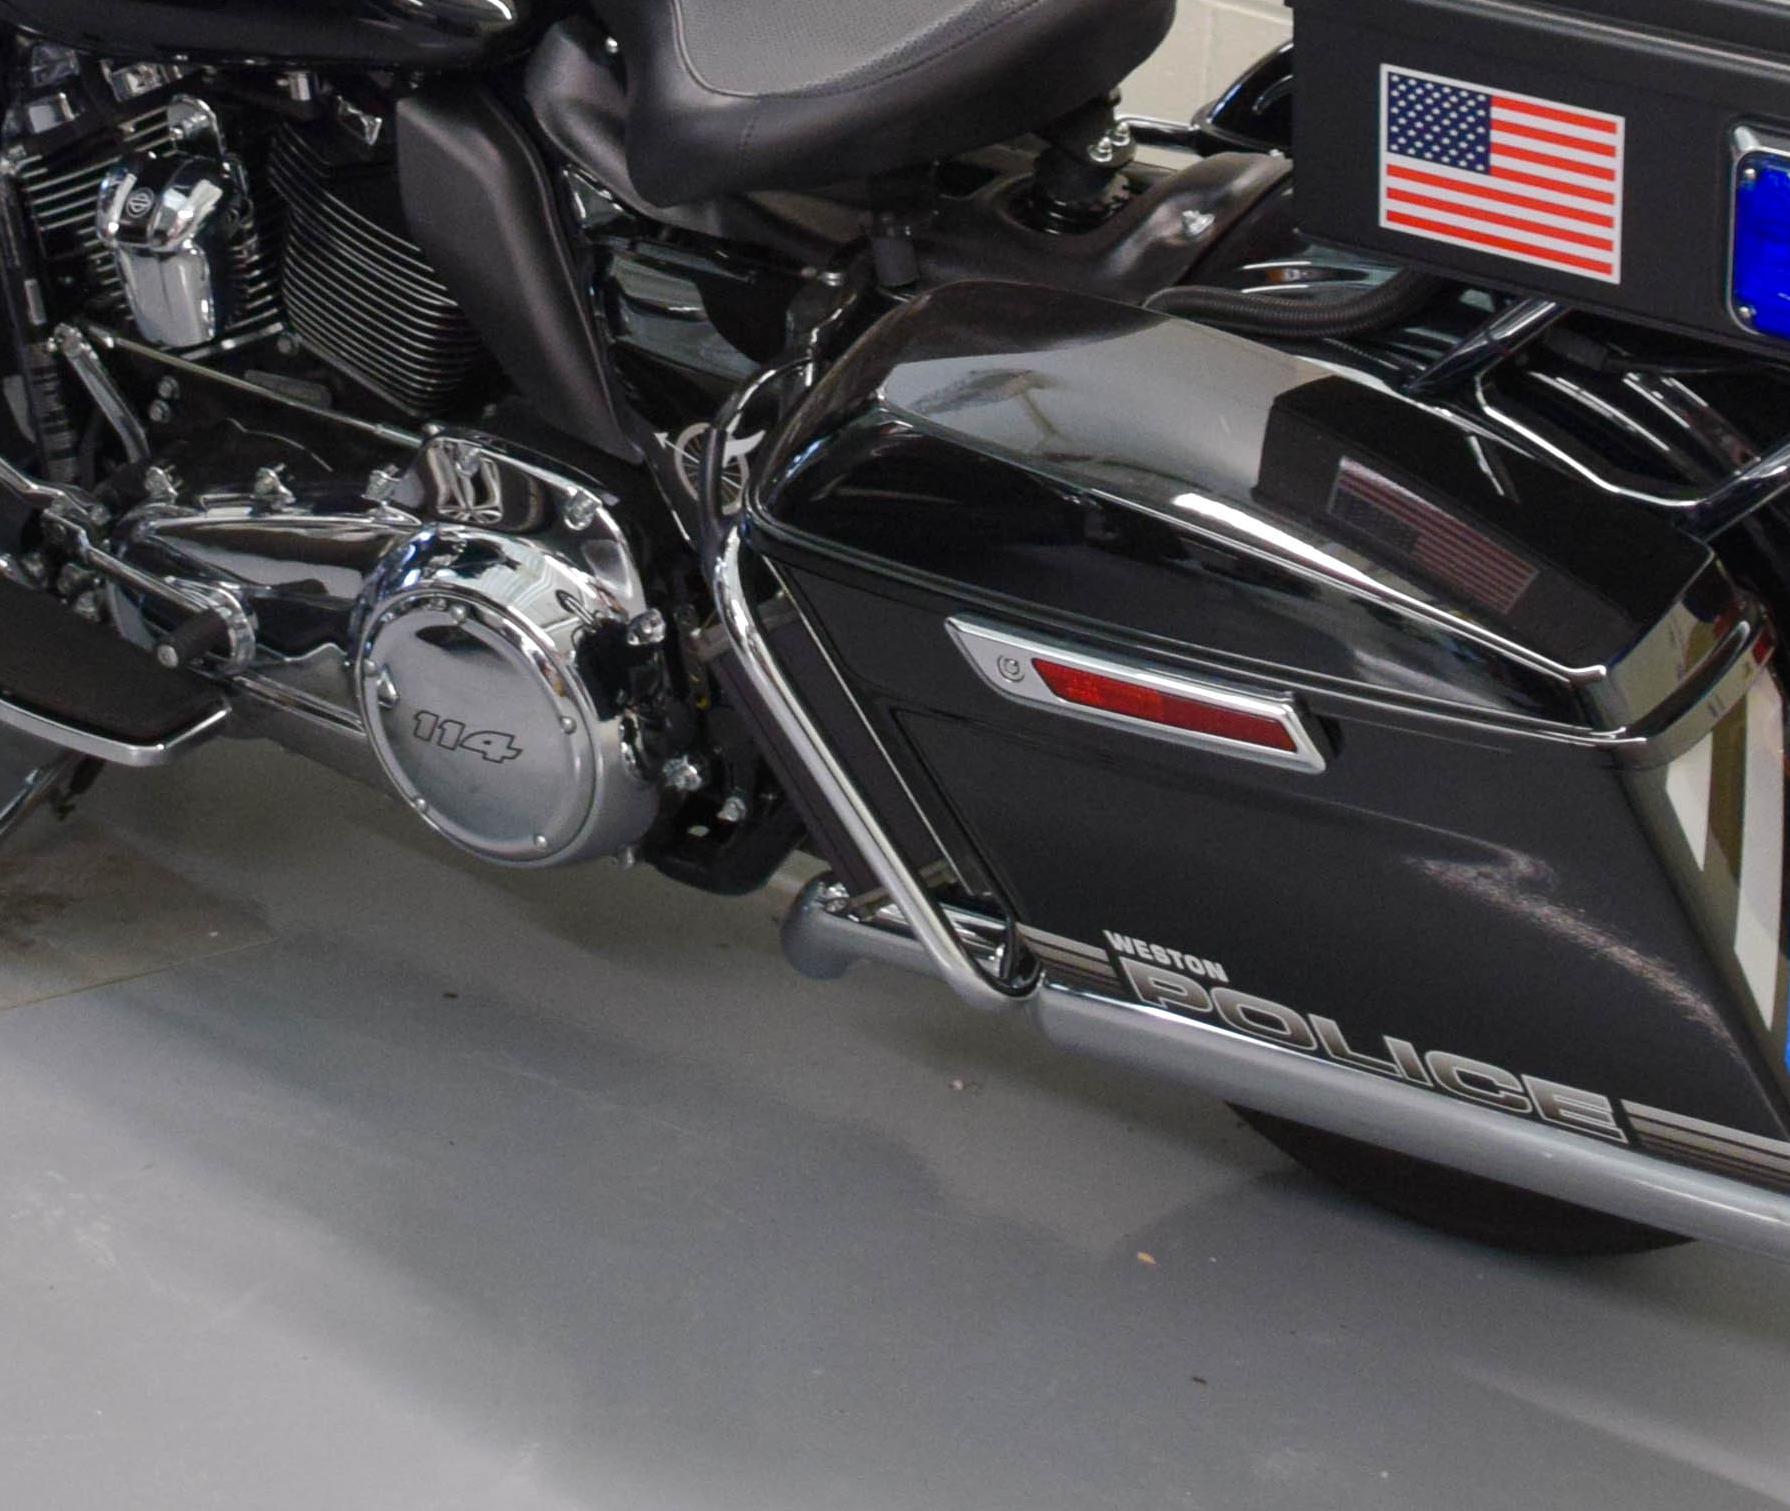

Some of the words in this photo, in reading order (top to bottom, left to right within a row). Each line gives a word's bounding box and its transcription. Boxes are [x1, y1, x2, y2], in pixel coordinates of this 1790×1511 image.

[413, 710, 523, 764] 114
[1102, 929, 1230, 983] WESTON
[1118, 958, 1631, 1145] POLICE
